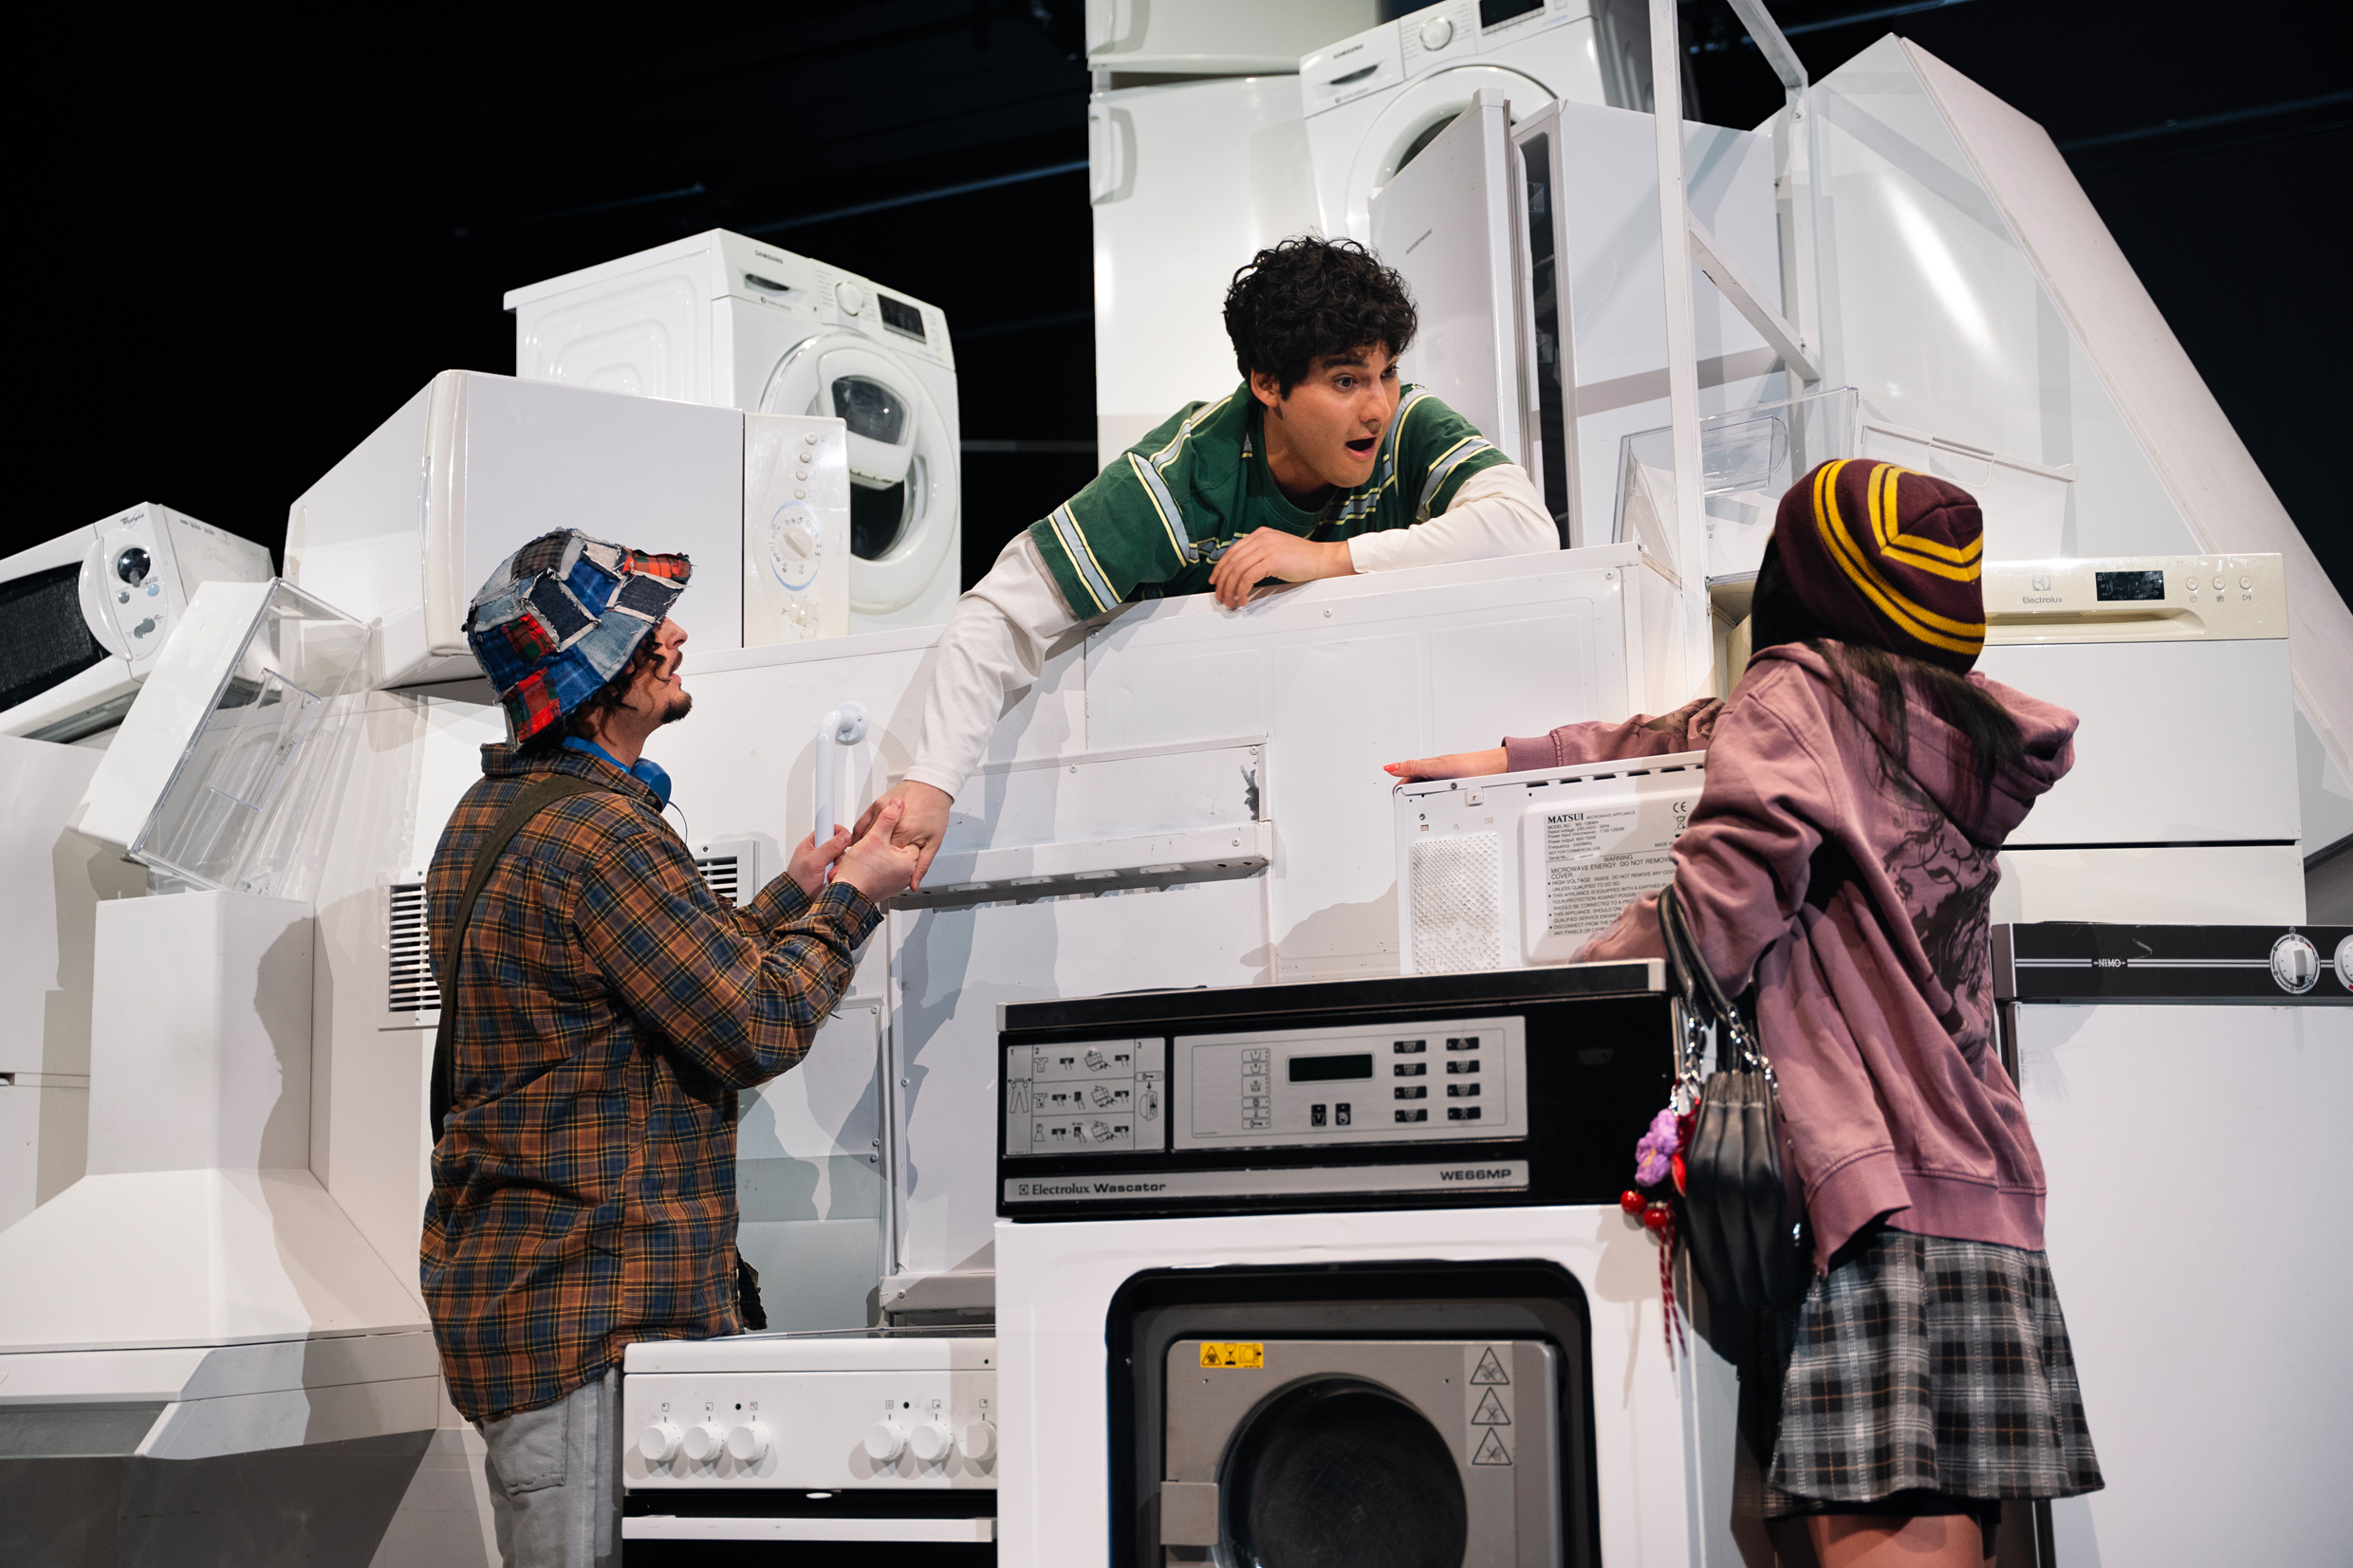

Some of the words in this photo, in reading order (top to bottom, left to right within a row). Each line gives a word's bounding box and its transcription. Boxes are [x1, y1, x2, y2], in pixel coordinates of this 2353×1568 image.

[2022, 596, 2063, 604] Electrolux
[1547, 813, 1584, 824] MATSUI
[1603, 854, 1633, 862] WARNING
[1551, 865, 1589, 874] MICROWAVE
[2098, 959, 2121, 968] NIMO
[1440, 1169, 1511, 1181] WE66MP
[1032, 1183, 1090, 1195] Electrolux
[1094, 1182, 1167, 1193] Wascator
